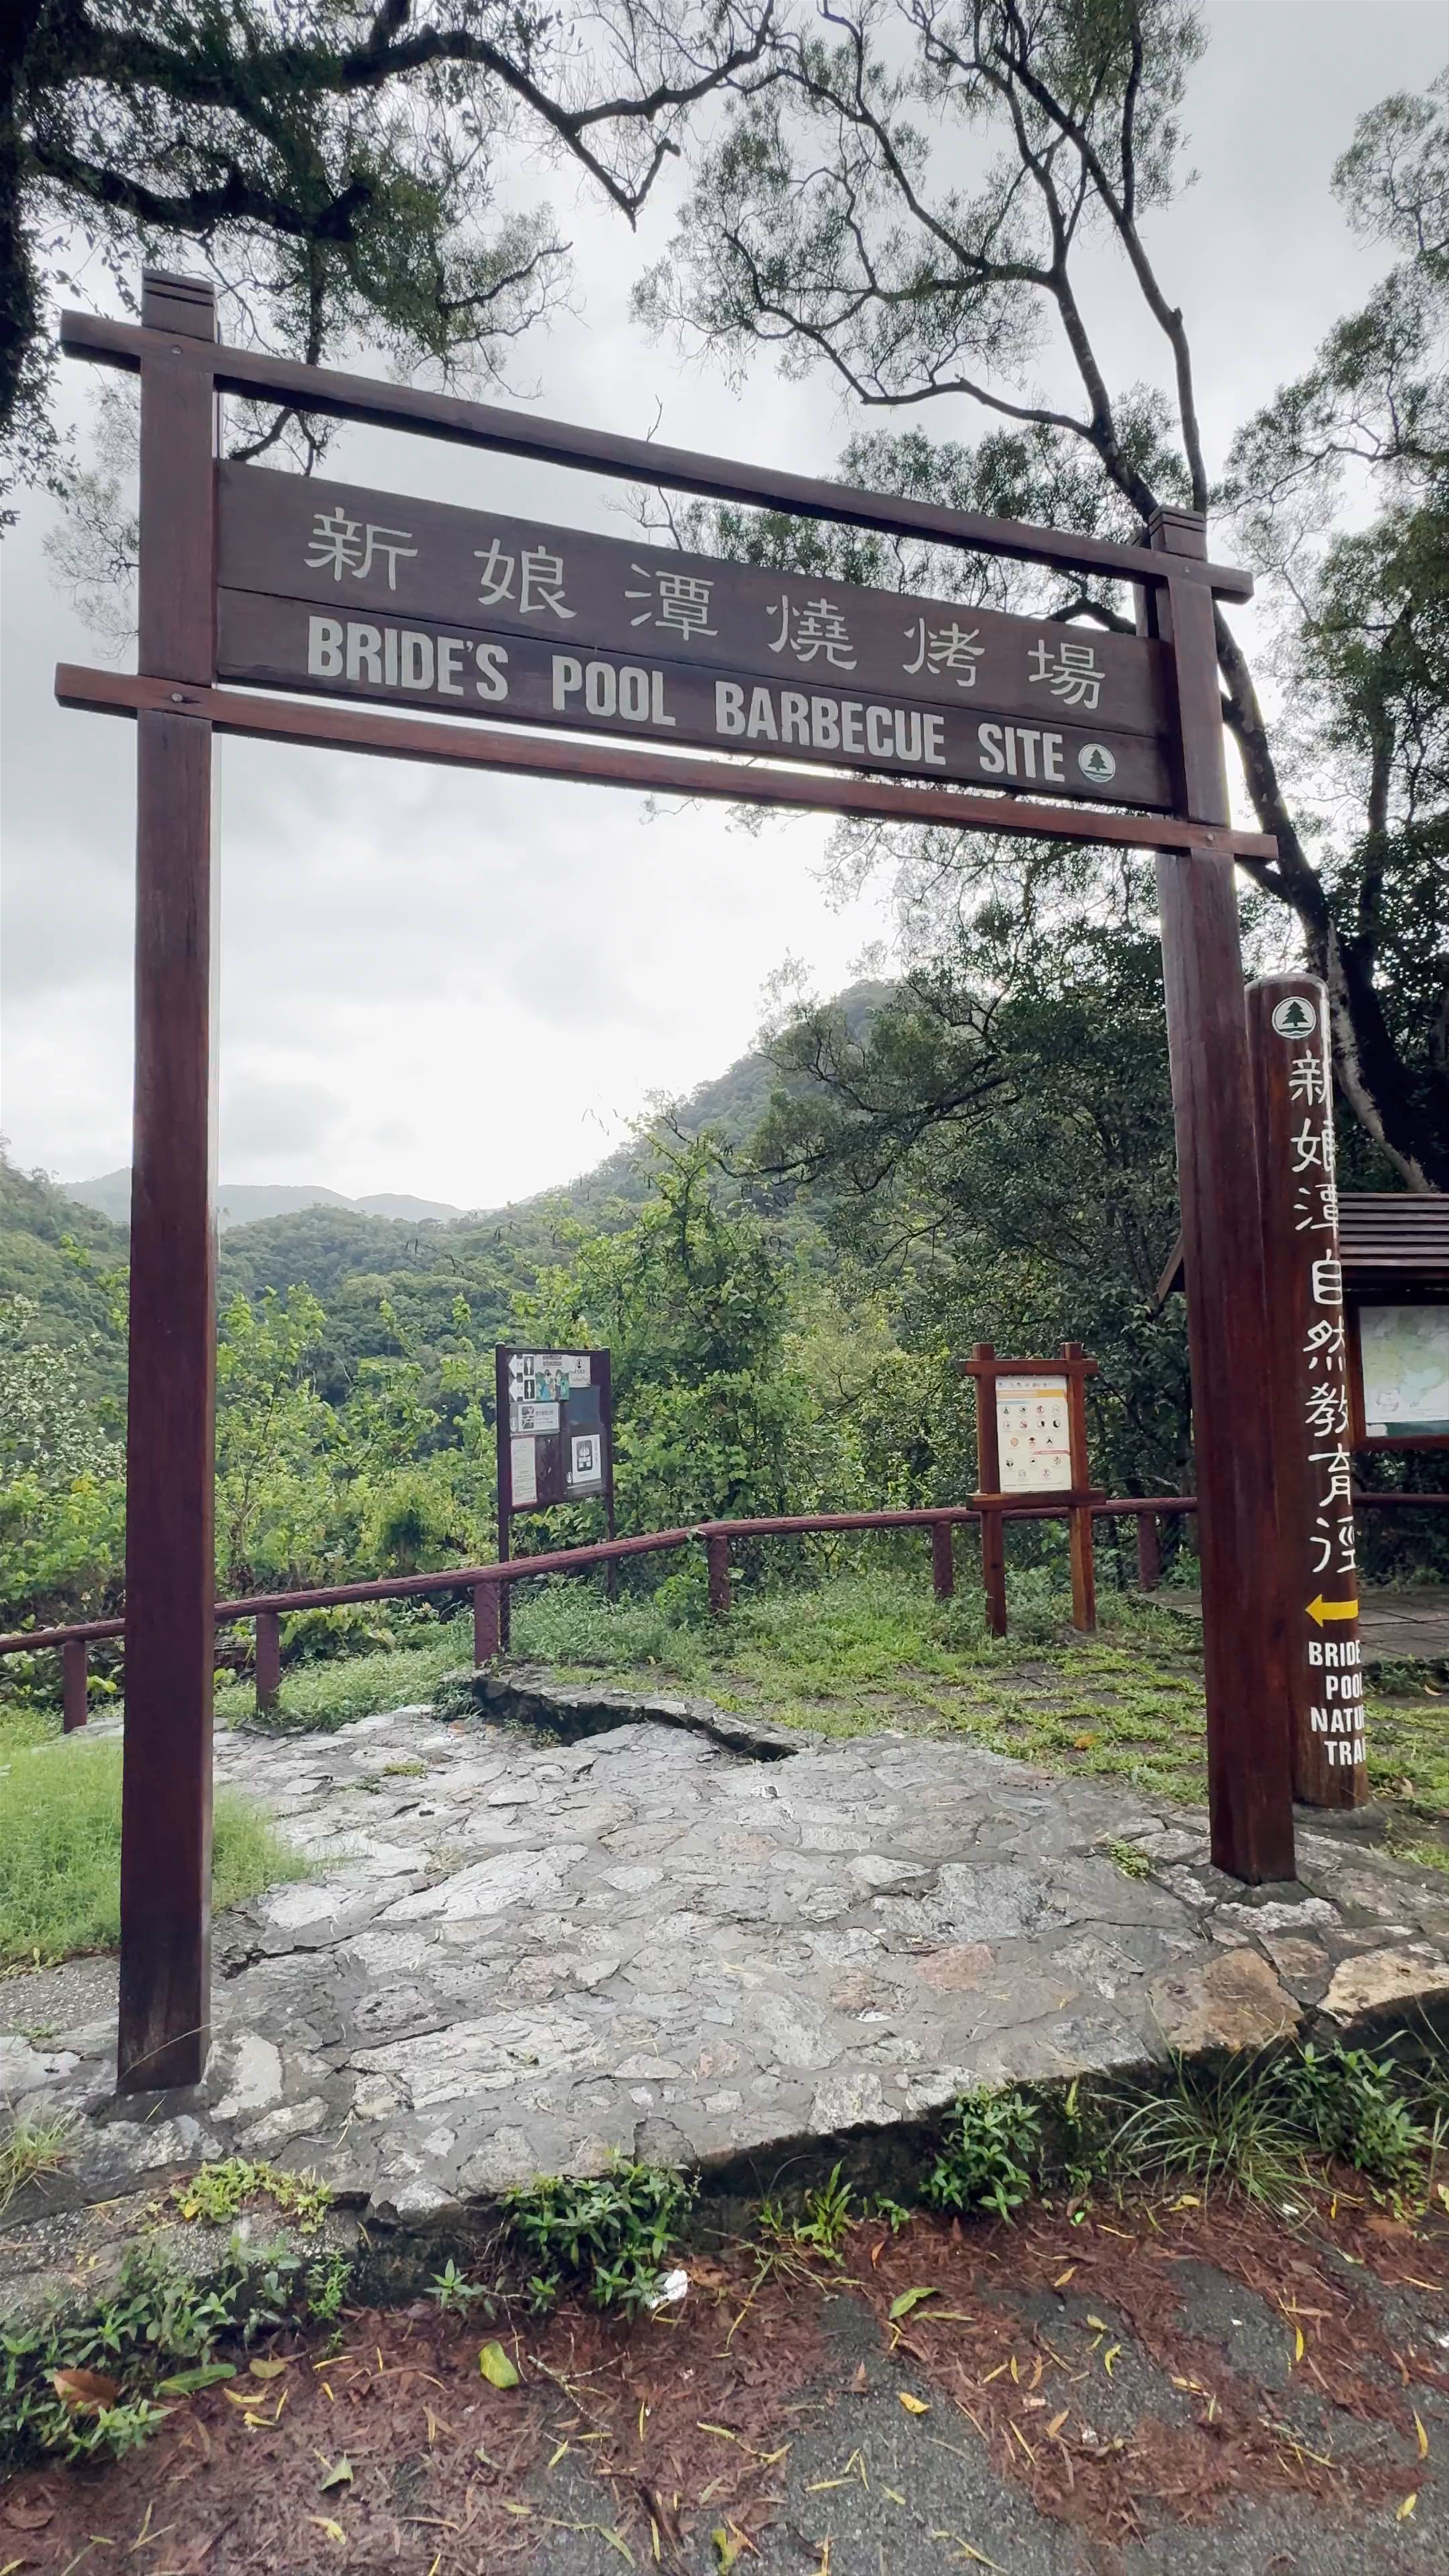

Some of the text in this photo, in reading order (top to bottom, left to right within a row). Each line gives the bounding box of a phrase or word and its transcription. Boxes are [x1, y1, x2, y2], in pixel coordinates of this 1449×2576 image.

[304, 506, 1106, 709] 新娘潭燒烤場
[308, 615, 1065, 782] BRIDE'S POOL BARBECUE SITE
